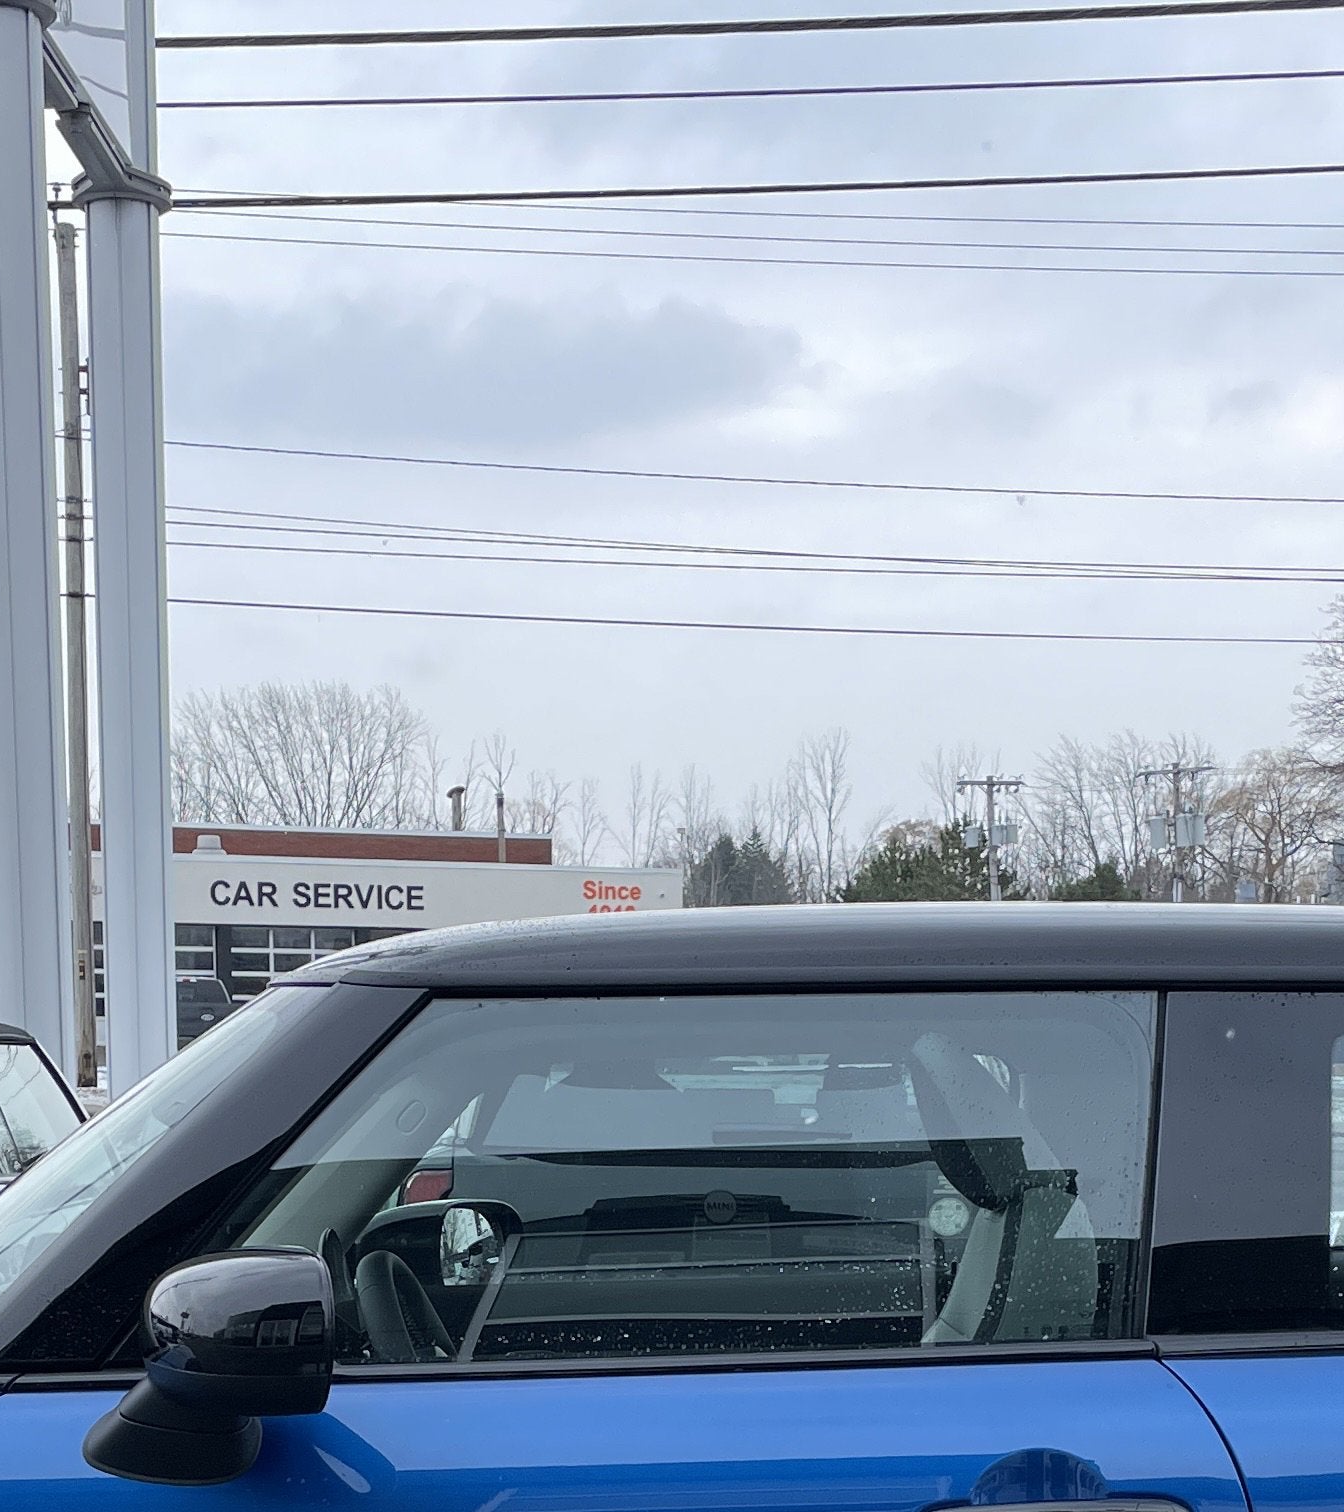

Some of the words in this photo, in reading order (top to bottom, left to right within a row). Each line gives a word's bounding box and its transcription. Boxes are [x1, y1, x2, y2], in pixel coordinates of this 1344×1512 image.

[210, 880, 279, 908] CAR
[292, 881, 425, 911] SERVICE
[583, 880, 641, 901] Since
